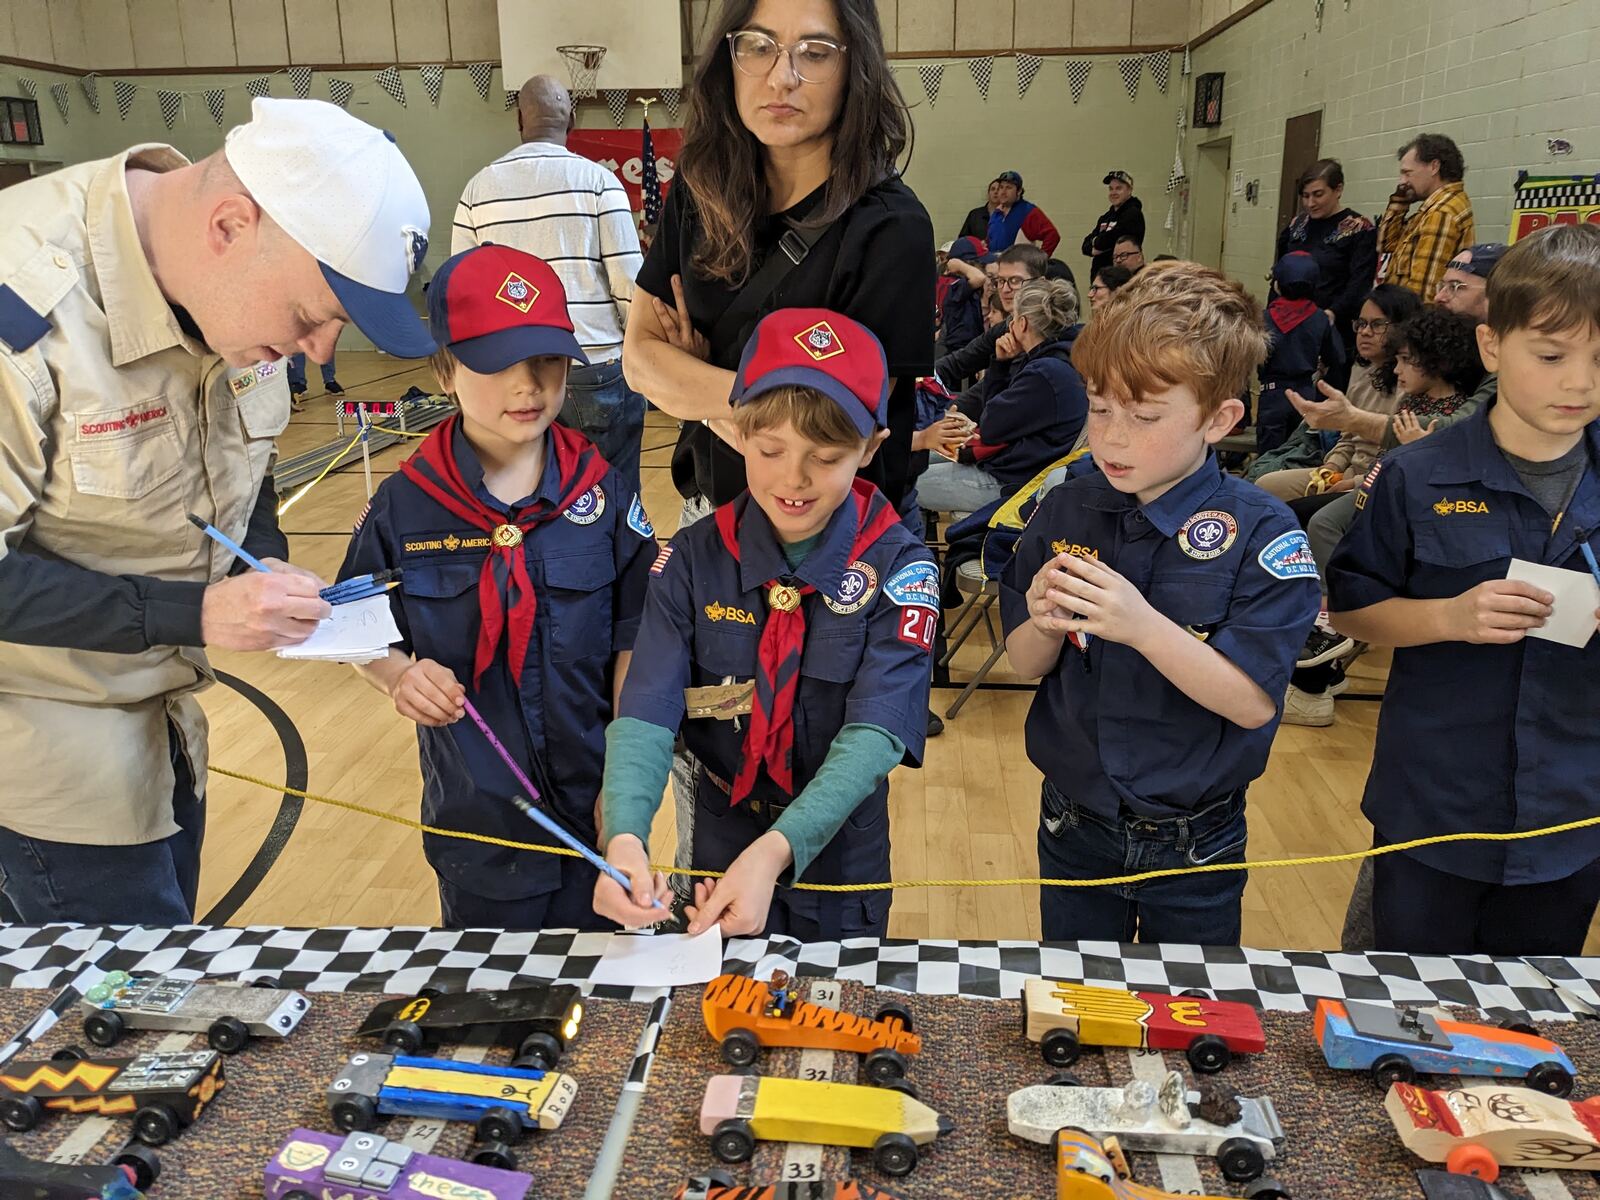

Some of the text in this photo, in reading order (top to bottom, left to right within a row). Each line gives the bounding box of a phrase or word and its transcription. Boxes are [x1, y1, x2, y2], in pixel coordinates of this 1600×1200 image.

[81, 406, 168, 435] SCOUTING AMERICA
[1455, 501, 1490, 514] BSA
[405, 538, 492, 552] SCOUTING AMERIC
[1070, 544, 1099, 560] BSA
[1264, 540, 1291, 560] NATIONAL
[888, 569, 916, 587] NATIONAL
[725, 606, 757, 625] BSA
[903, 609, 934, 645] 20
[817, 990, 834, 1001] 31
[805, 1068, 830, 1081] 32
[412, 1124, 438, 1139] 27
[788, 1163, 816, 1179] 33
